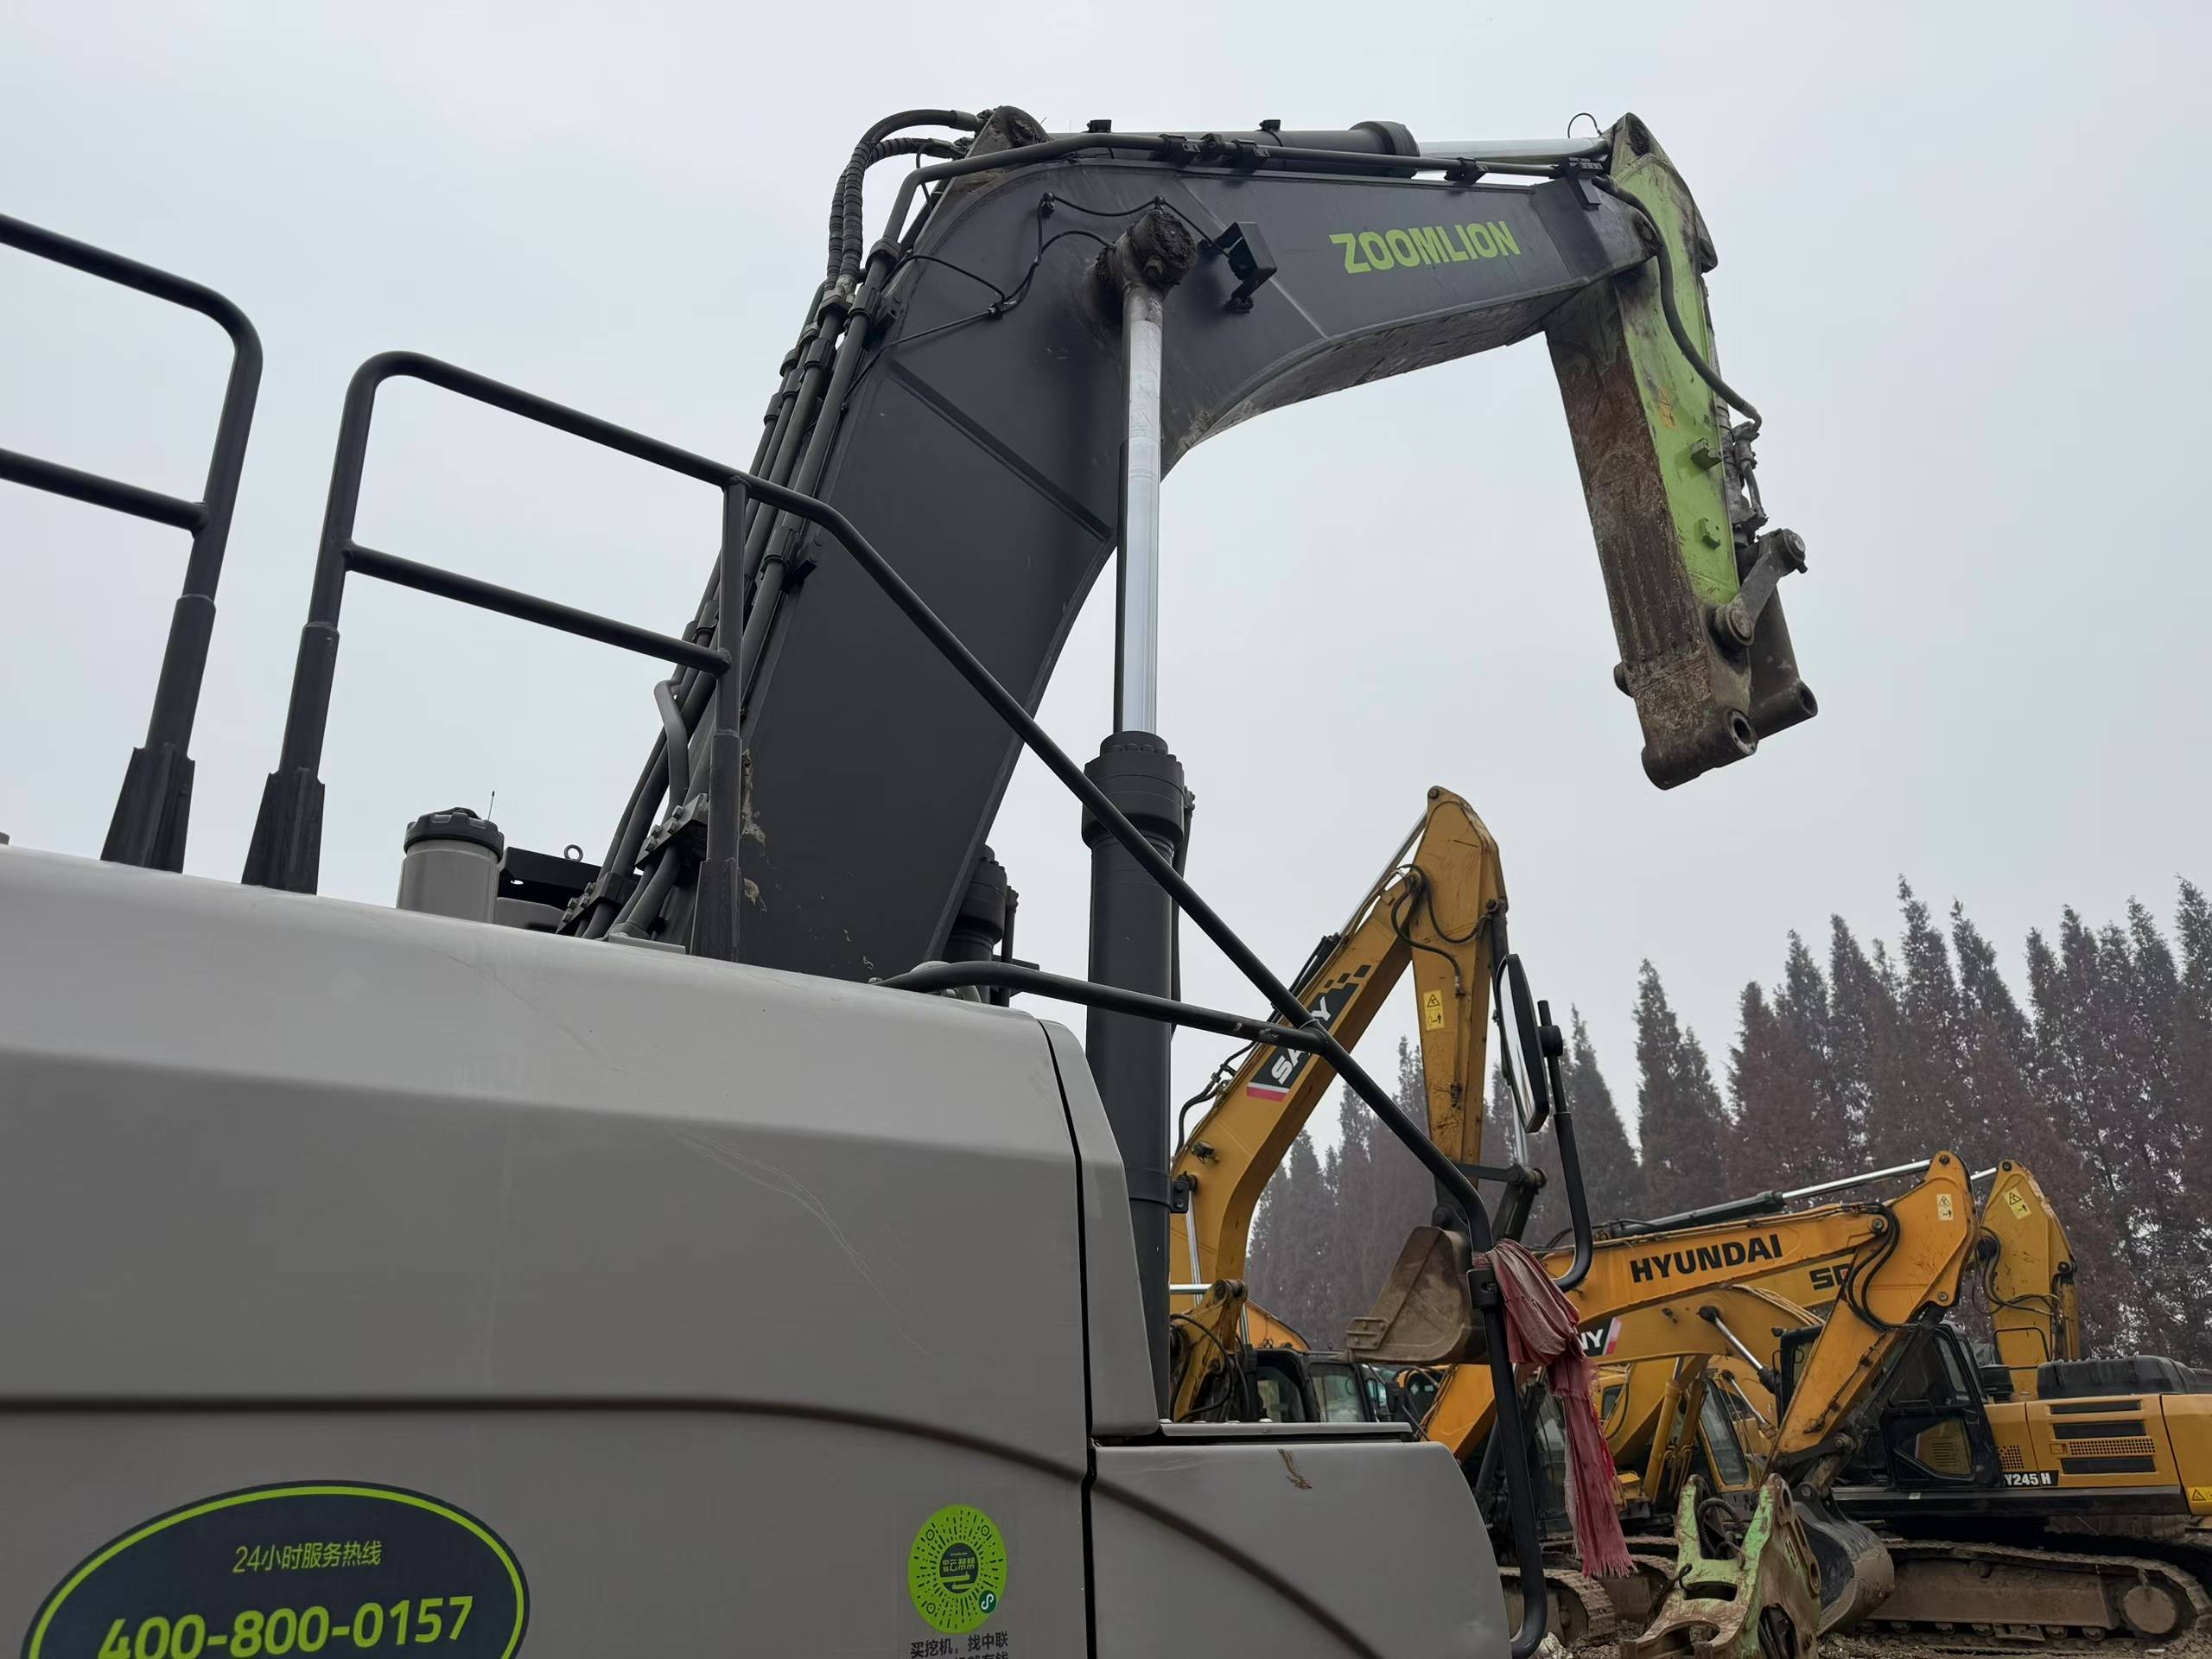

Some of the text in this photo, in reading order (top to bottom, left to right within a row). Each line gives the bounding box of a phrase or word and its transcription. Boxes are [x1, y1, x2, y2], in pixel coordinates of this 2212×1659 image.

[1329, 221, 1521, 274] ZOOMLION
[1271, 995, 1332, 1085] SAY
[1630, 1234, 1783, 1283] HYUNDAI
[232, 1540, 383, 1573] 24小时服务热线
[99, 1595, 474, 1659] 400-800-0157
